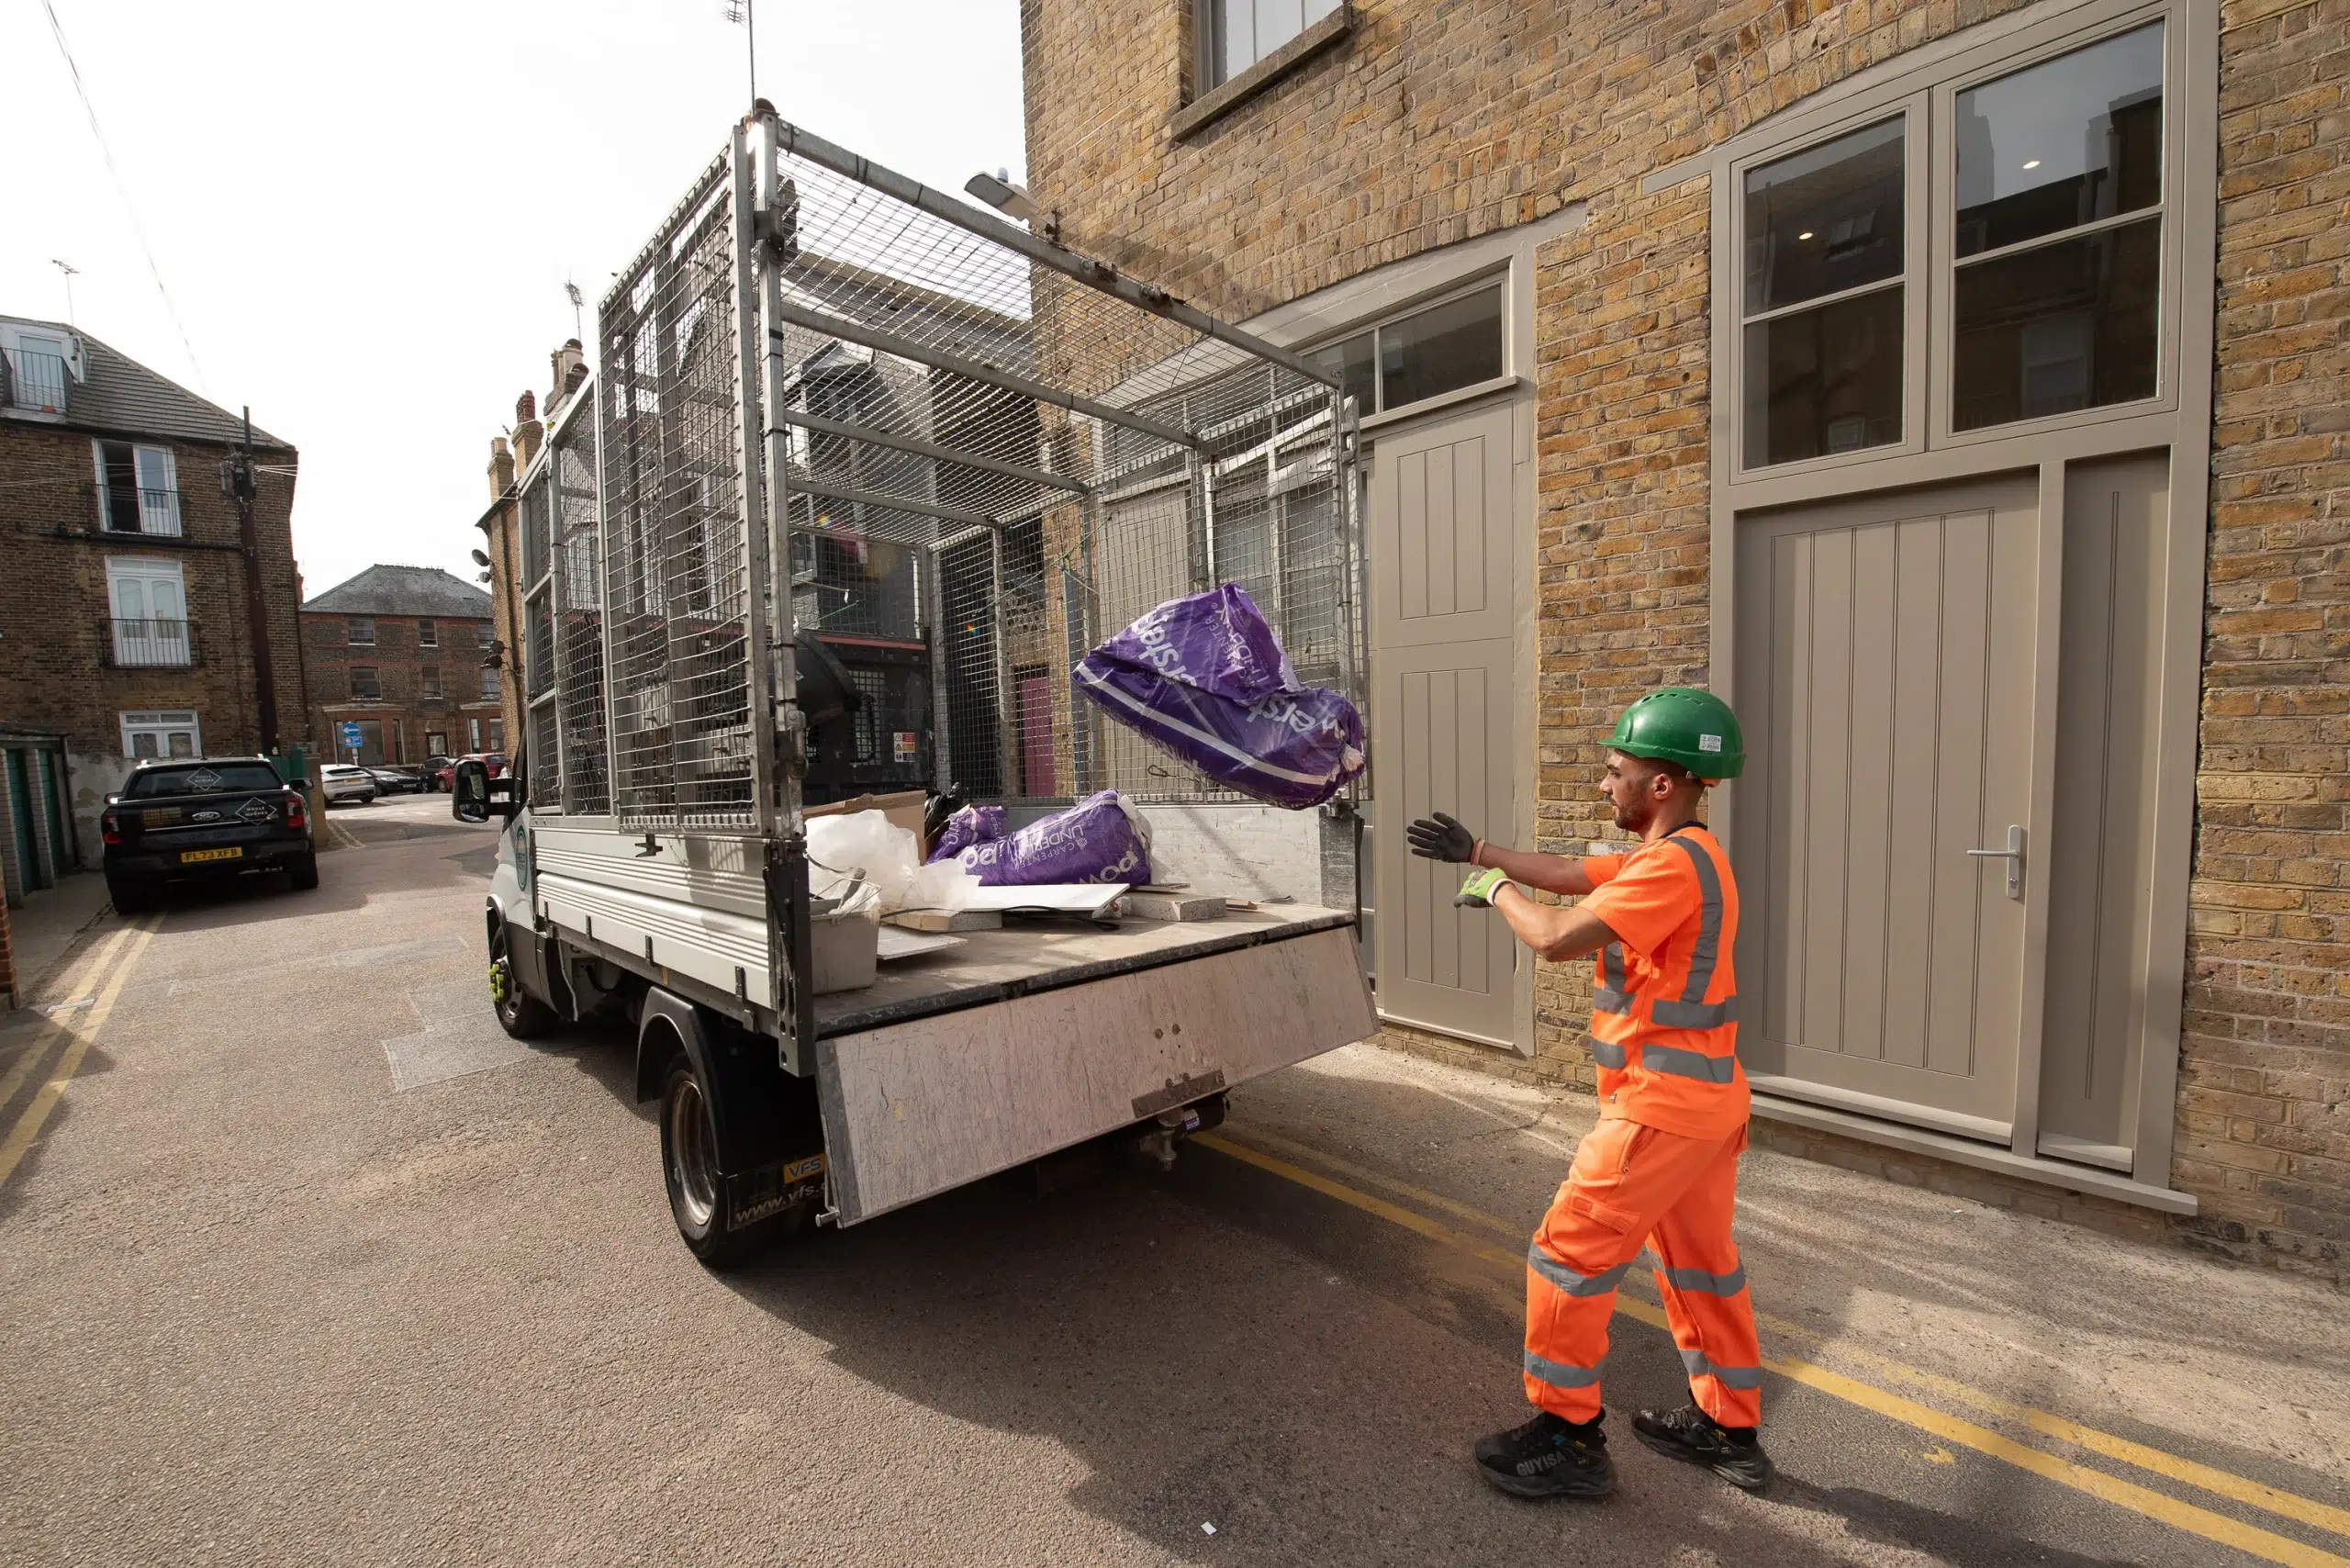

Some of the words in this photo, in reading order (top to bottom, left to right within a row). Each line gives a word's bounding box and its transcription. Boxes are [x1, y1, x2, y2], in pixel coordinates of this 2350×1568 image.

[185, 851, 214, 861] FL73
[217, 847, 238, 857] XFB
[788, 1158, 821, 1178] VFS
[1516, 1450, 1567, 1477] GUYISA
